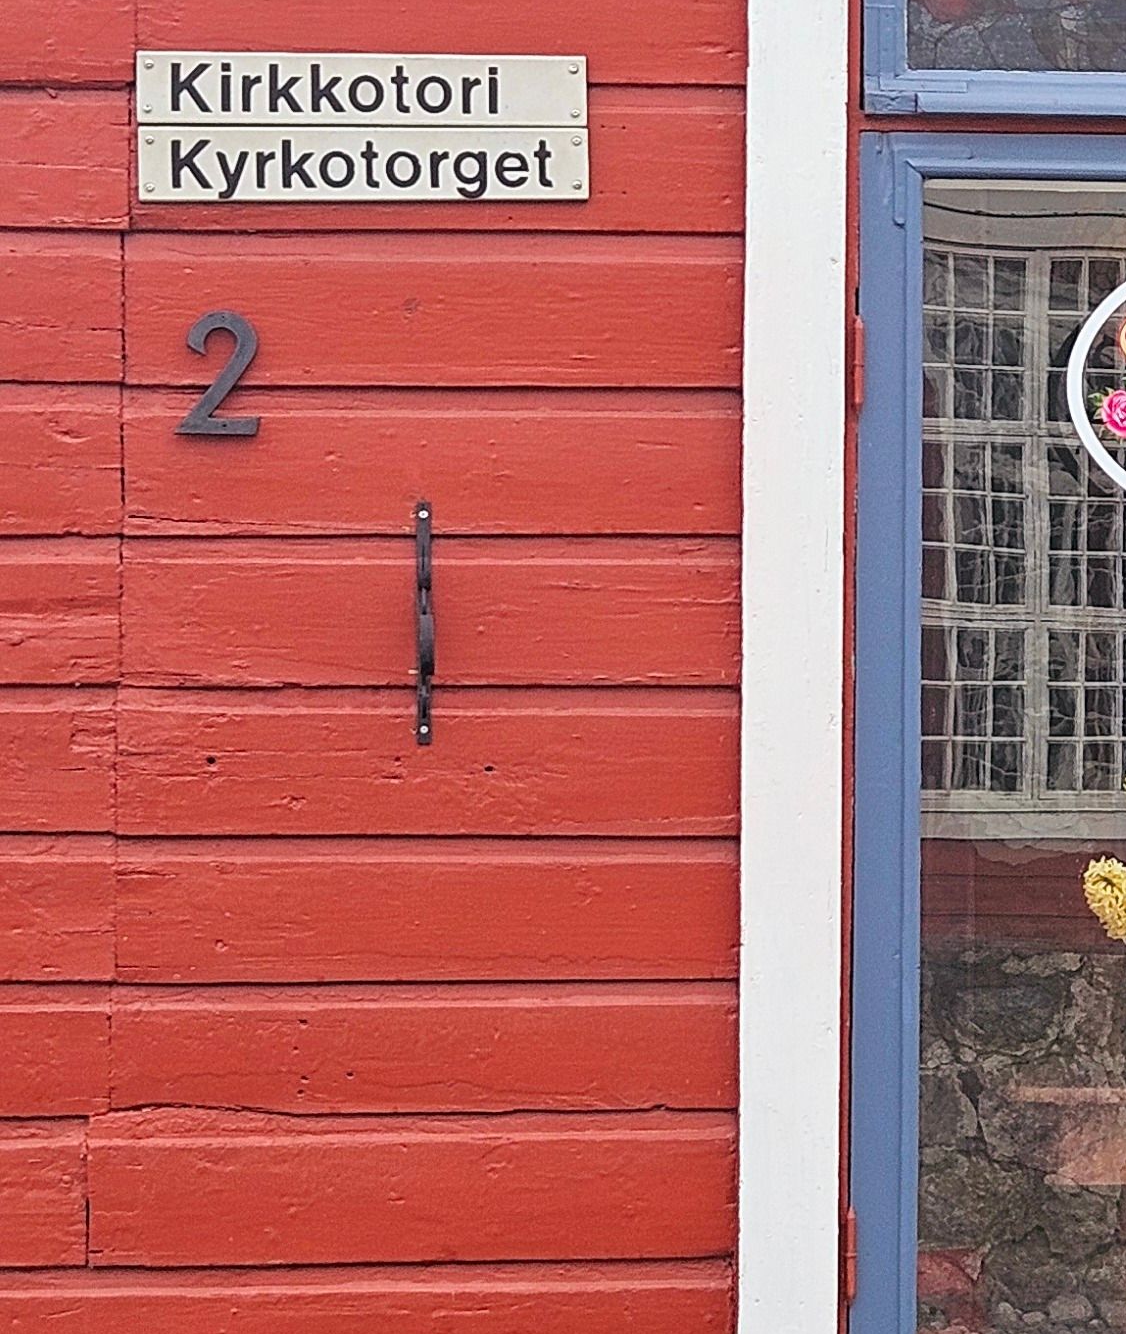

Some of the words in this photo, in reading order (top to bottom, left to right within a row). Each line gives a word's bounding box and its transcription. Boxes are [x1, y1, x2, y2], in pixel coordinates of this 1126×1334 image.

[170, 62, 500, 115] Kirkkotori
[170, 139, 554, 199] Kyrkotorget
[174, 310, 261, 436] 2
